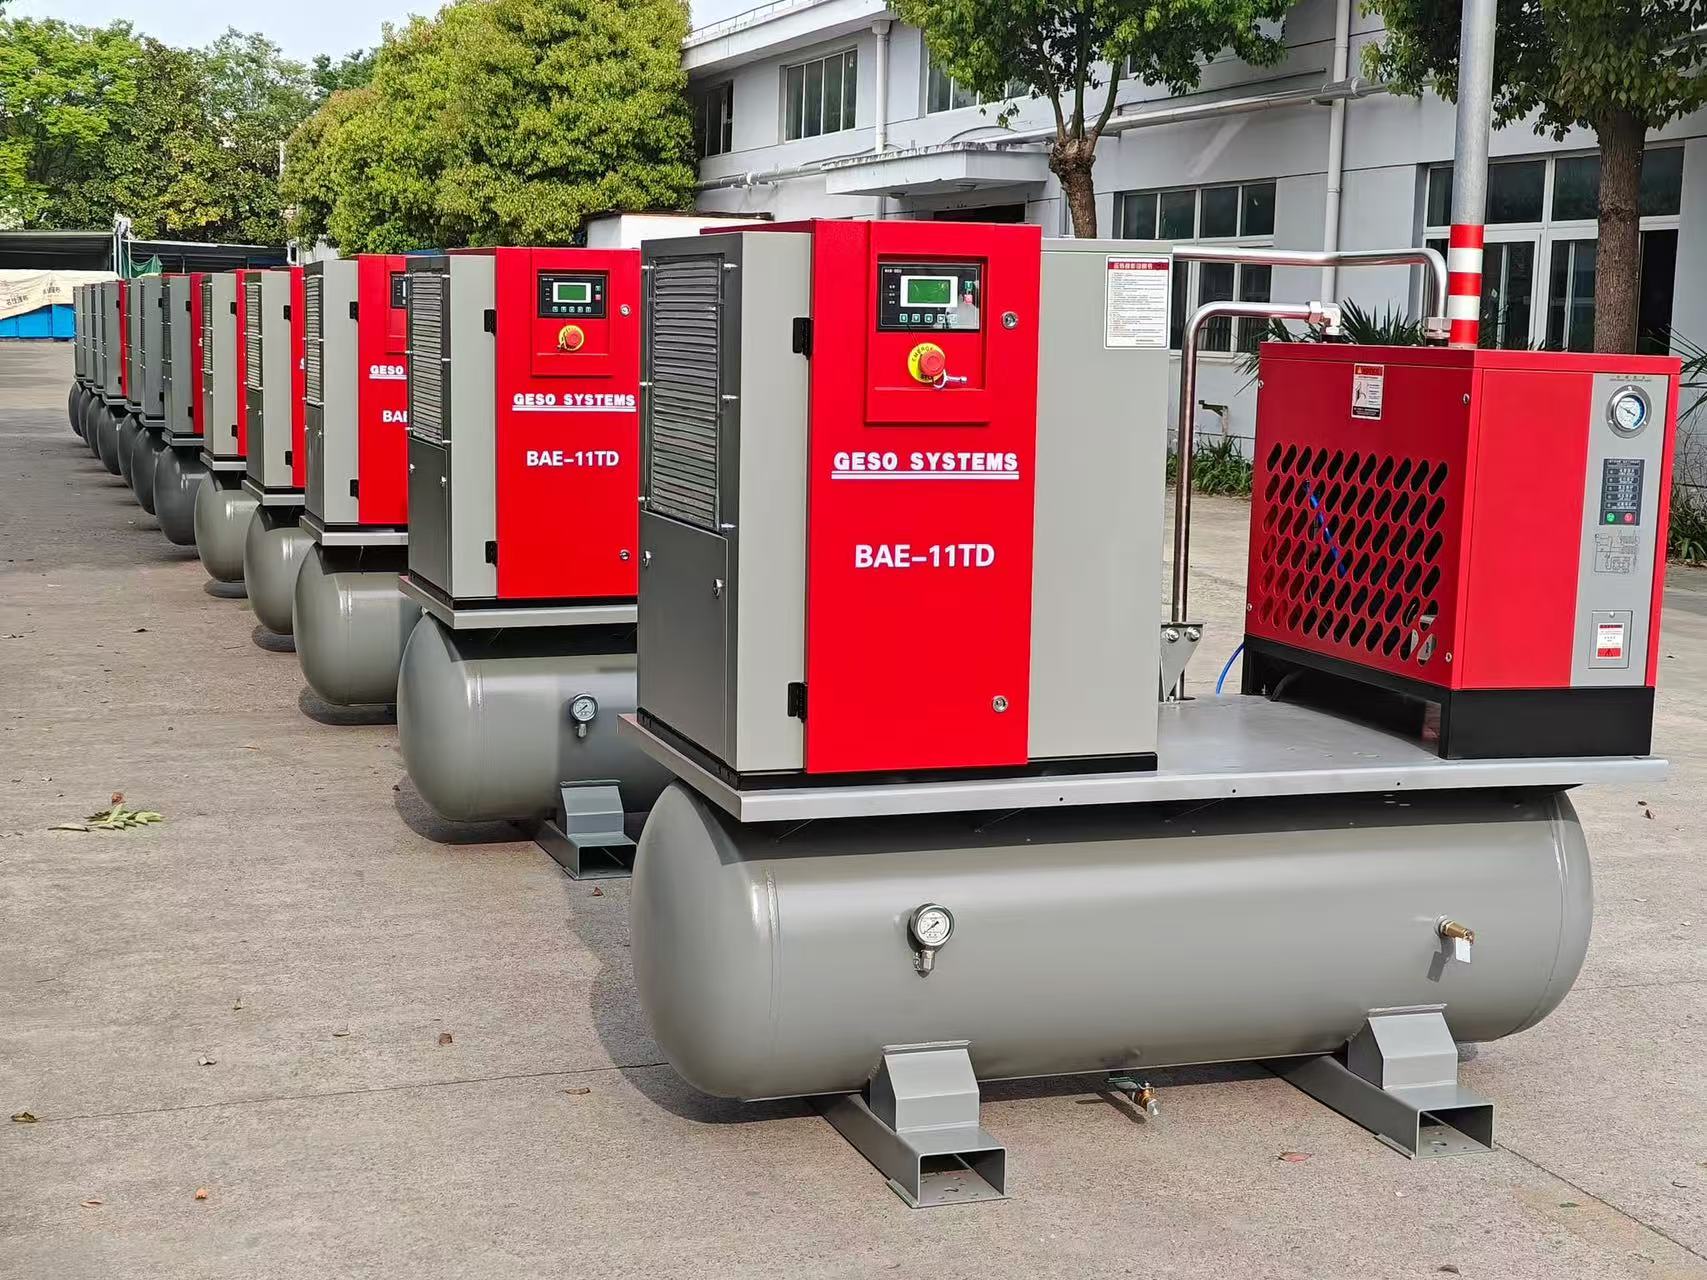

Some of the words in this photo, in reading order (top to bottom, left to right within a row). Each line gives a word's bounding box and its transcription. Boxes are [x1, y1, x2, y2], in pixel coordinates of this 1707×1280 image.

[369, 364, 404, 375] GESO
[513, 393, 556, 406] GESO
[563, 394, 636, 407] SYSTEMS
[526, 450, 620, 467] BAE-11TD
[833, 452, 898, 471] GESO
[910, 452, 1018, 471] SYSTEMS
[855, 543, 996, 569] BAE-11TD
